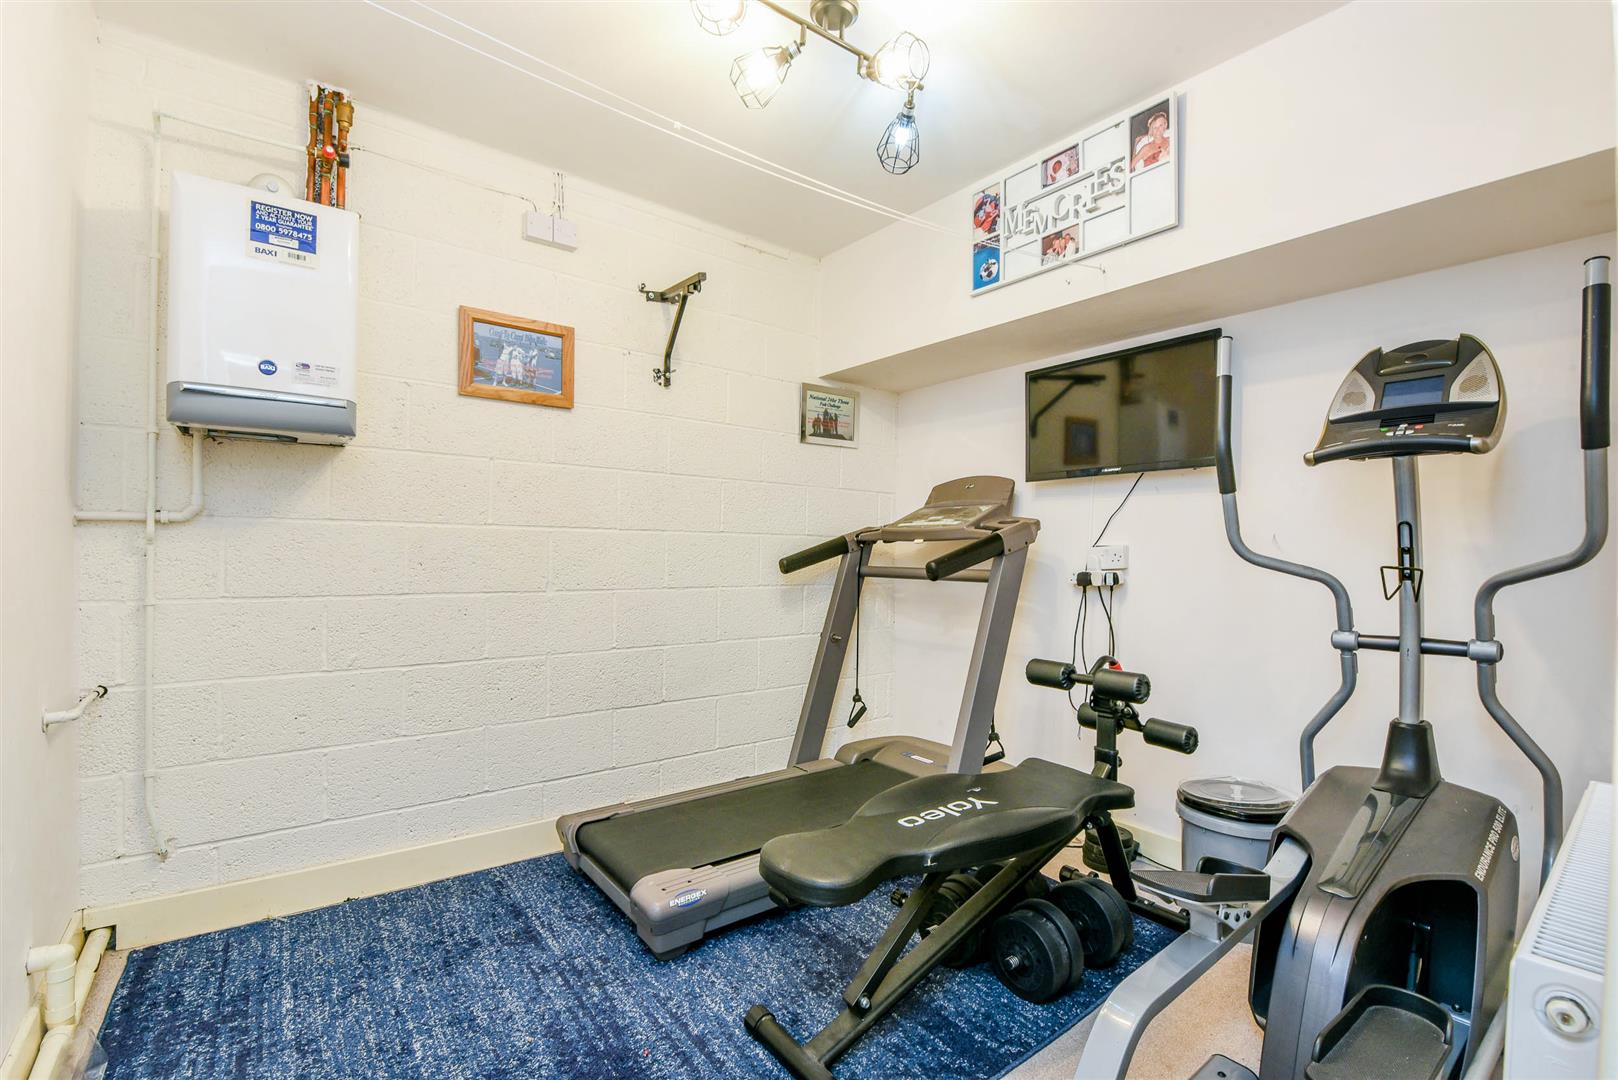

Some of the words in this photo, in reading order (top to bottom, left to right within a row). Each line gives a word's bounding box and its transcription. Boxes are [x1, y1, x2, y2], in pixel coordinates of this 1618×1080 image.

[1003, 160, 1125, 238] MEMORIES
[255, 203, 292, 217] REGISTER
[294, 212, 313, 221] NOW
[262, 215, 276, 223] YEAR
[269, 212, 296, 222] ACTIVATE
[255, 222, 277, 233] 0800
[278, 227, 313, 241] 5978475
[254, 247, 278, 257] BAXI
[260, 364, 276, 372] BAXI
[897, 797, 999, 827] Yaleo
[1474, 841, 1496, 882] ENDURANCE
[1488, 829, 1500, 847] PRO
[1495, 805, 1507, 824] ELITE
[669, 889, 707, 907] ENERGEX
